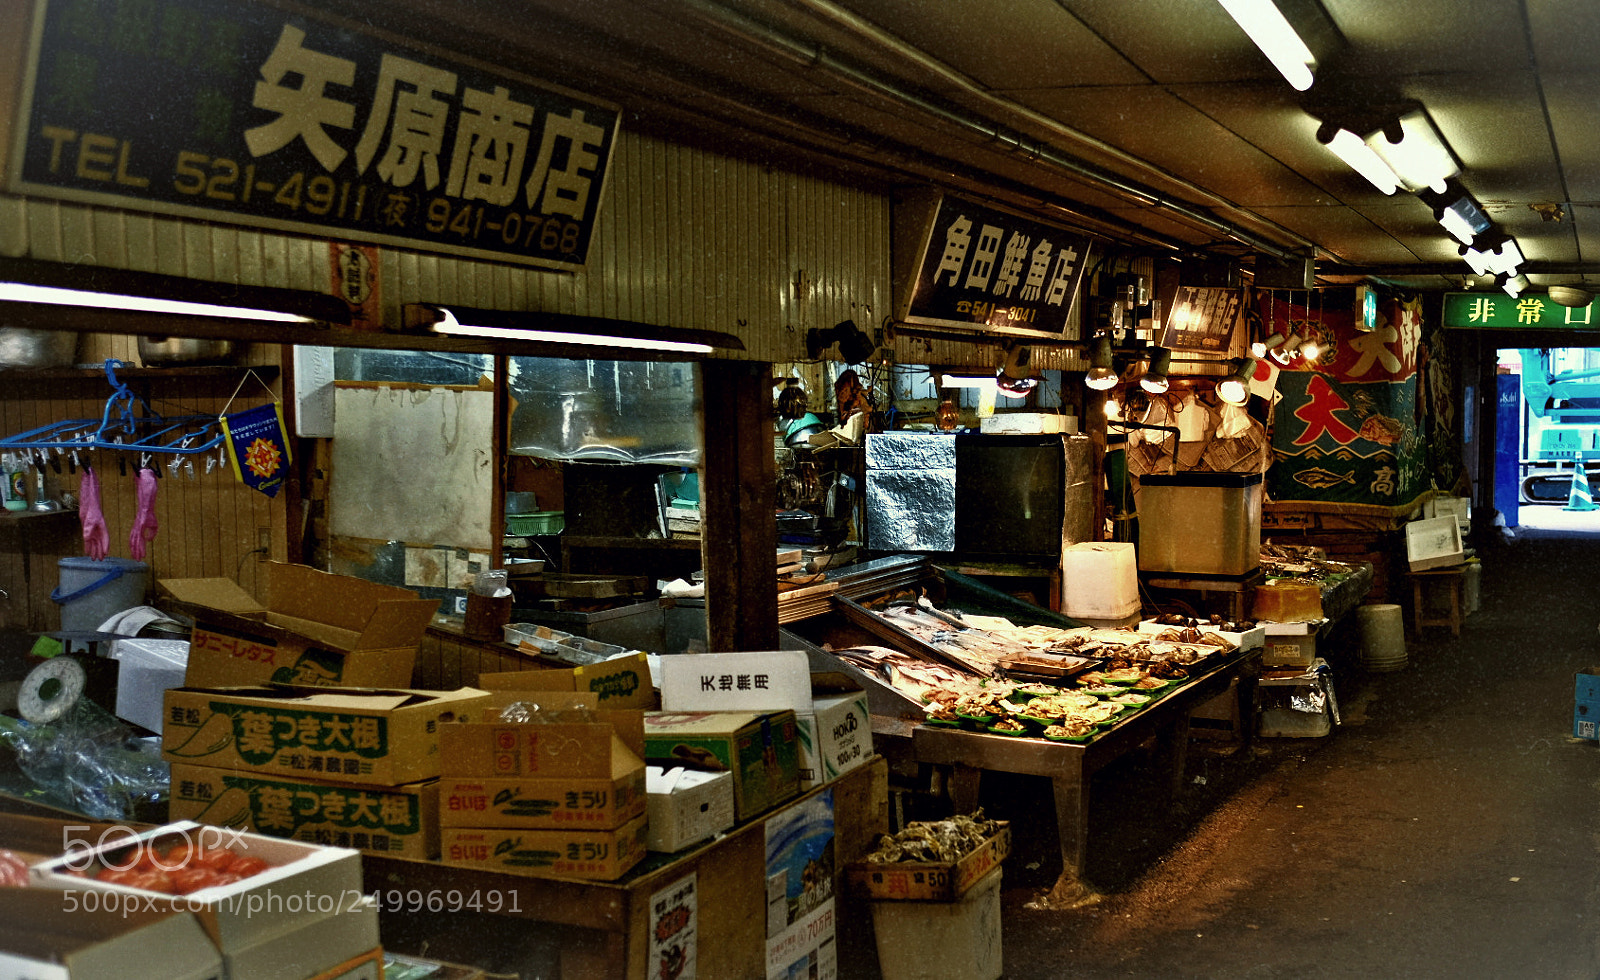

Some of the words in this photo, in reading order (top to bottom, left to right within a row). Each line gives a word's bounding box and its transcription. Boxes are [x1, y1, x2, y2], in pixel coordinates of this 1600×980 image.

[244, 24, 604, 221] 矢原商店
[42, 126, 149, 188] TEL
[174, 151, 366, 222] 521-4911
[425, 197, 580, 255] 941-0768
[934, 214, 1077, 307] 角田鮮魚店
[1468, 298, 1592, 324] 非常口
[194, 631, 277, 665] サニーレタス
[700, 674, 769, 692] 天地無用
[171, 706, 200, 724] 若松
[240, 709, 379, 755] 葉つき大根
[180, 780, 212, 799] 若松
[565, 790, 608, 808] きうり
[258, 784, 410, 831] 葉つき大根
[567, 842, 609, 860] きうり
